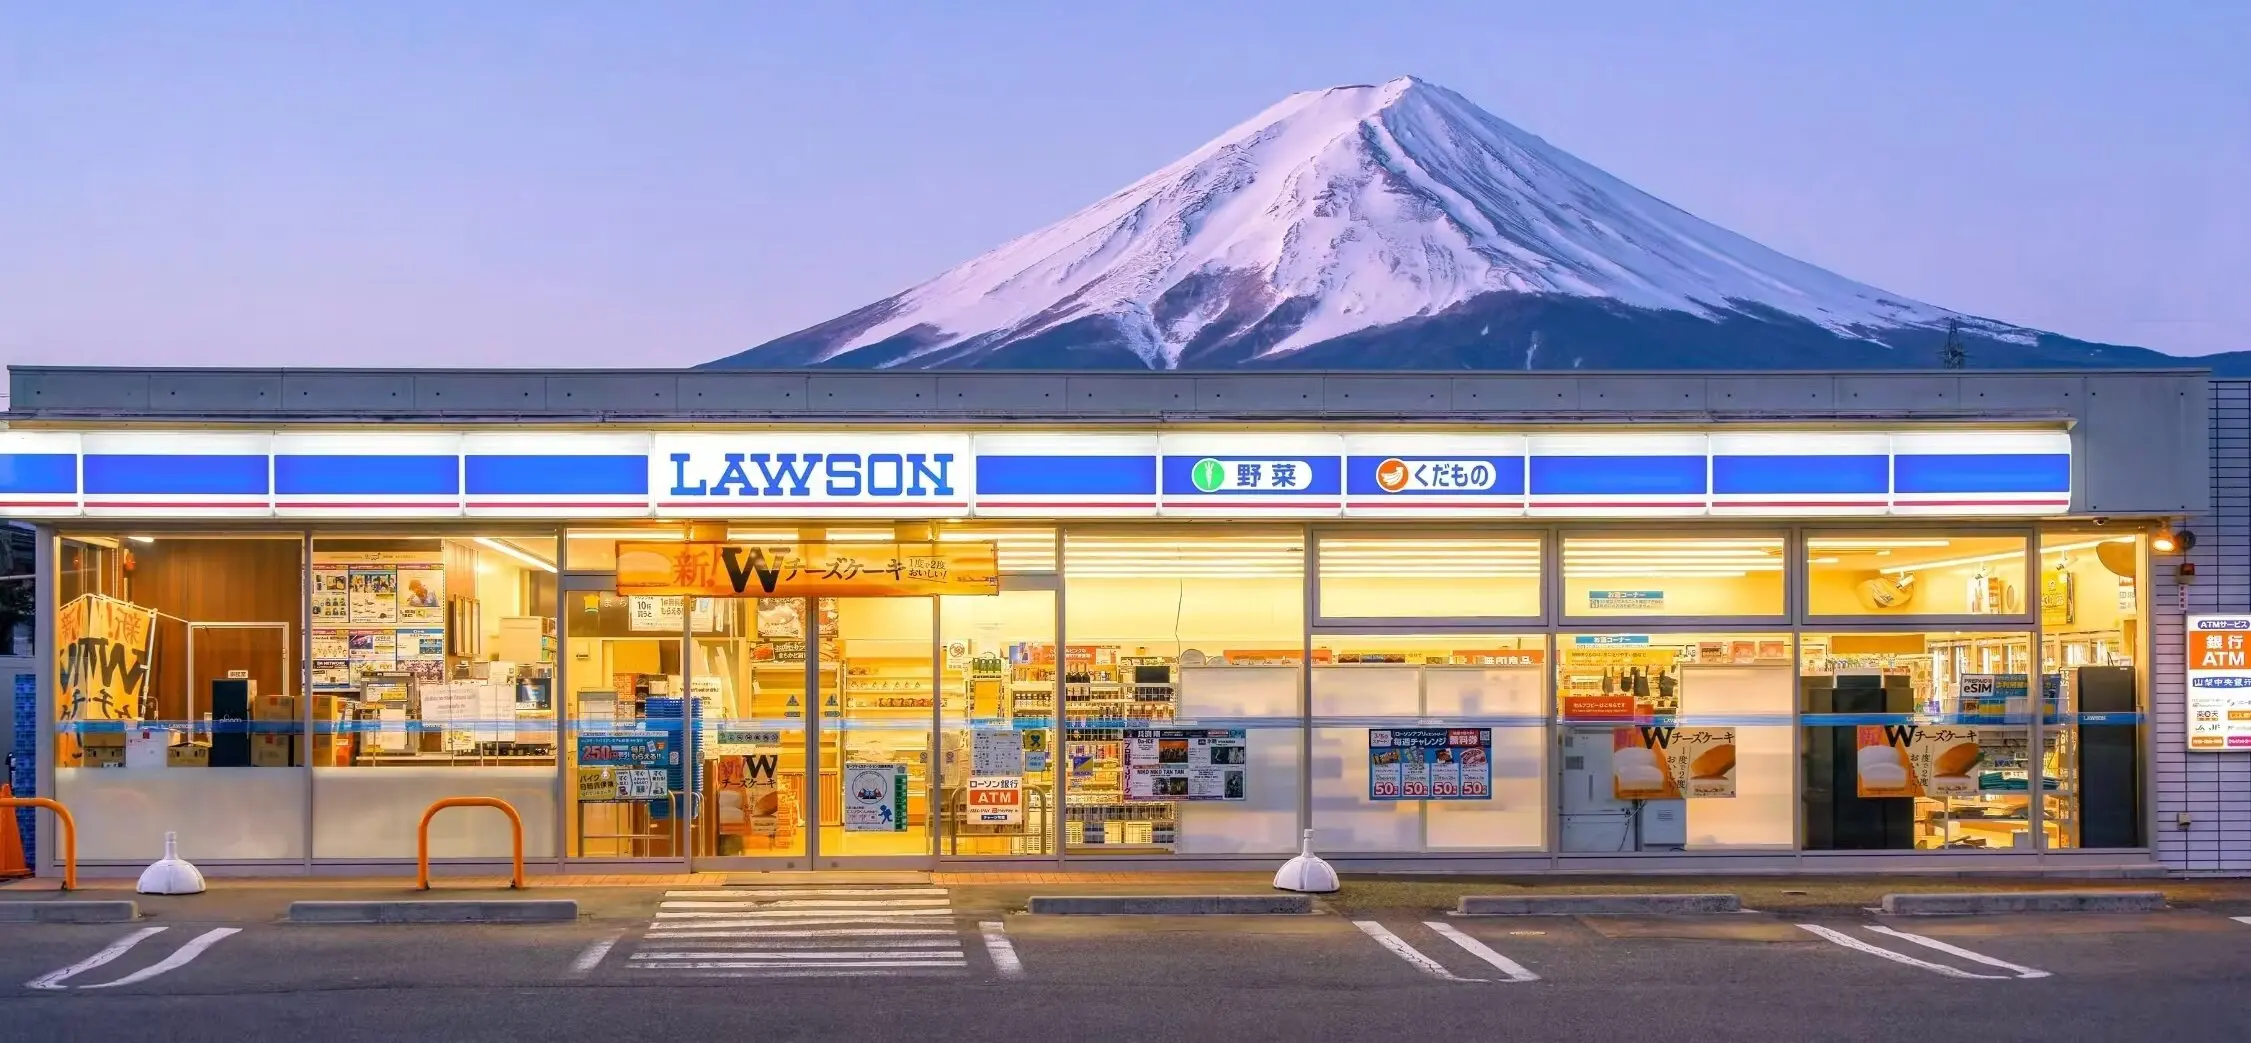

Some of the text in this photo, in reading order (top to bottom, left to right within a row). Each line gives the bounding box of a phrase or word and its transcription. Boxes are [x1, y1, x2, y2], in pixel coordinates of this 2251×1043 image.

[670, 453, 954, 496] LAWSON
[1413, 463, 1489, 487] くだもの
[909, 558, 947, 570] 1度で2度
[908, 569, 948, 579] おいしい!
[2200, 621, 2248, 629] ATMサービス
[2206, 635, 2243, 650] 銀行
[2202, 651, 2245, 666] ATM
[1963, 684, 1992, 693] eSIM
[1394, 738, 1447, 746] 毎週チャレンジ
[721, 778, 777, 788] チーズケーキ
[969, 779, 1019, 789] ローソン銀行
[978, 792, 1011, 803] ATM
